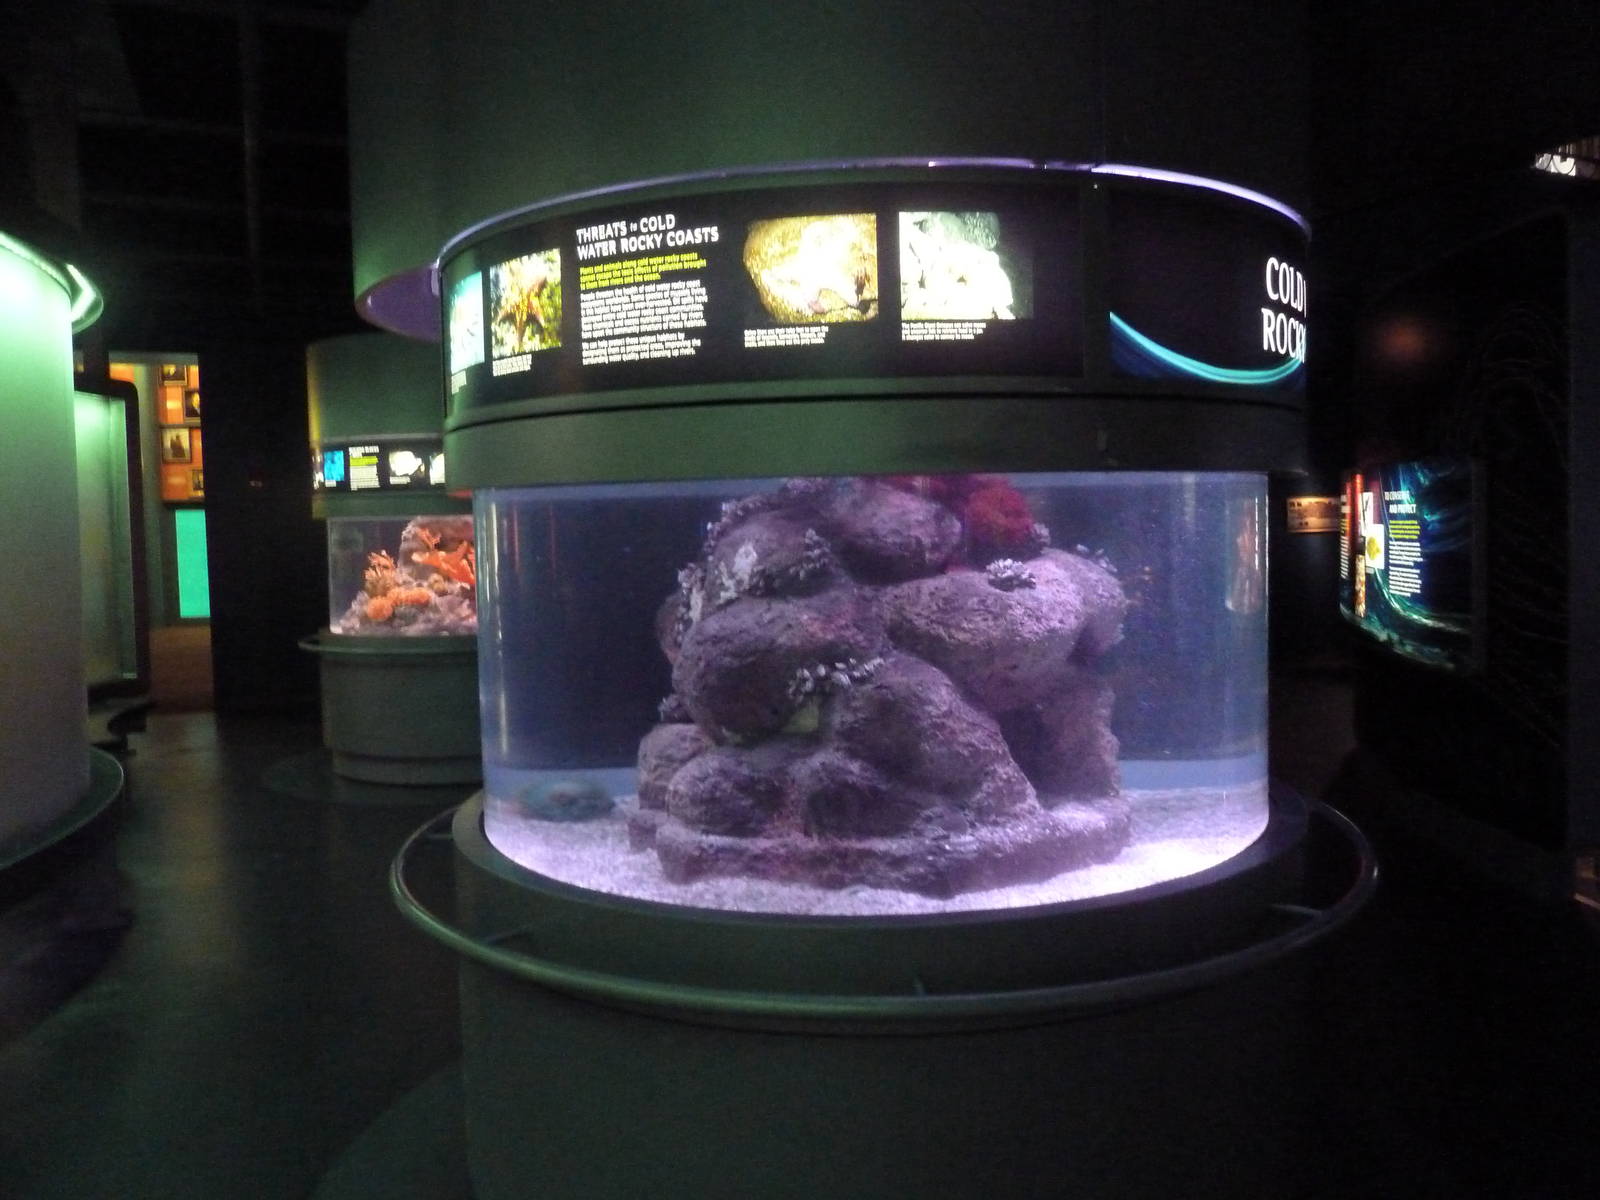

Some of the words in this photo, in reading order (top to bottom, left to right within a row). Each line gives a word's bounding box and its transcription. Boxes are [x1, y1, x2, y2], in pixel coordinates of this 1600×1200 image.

[576, 221, 627, 244] THREATS
[630, 223, 638, 232] to
[640, 214, 676, 232] COLD
[577, 241, 617, 260] WATER
[621, 233, 662, 252] ROCKY
[667, 226, 719, 246] COASTS
[1265, 256, 1303, 312] COLD
